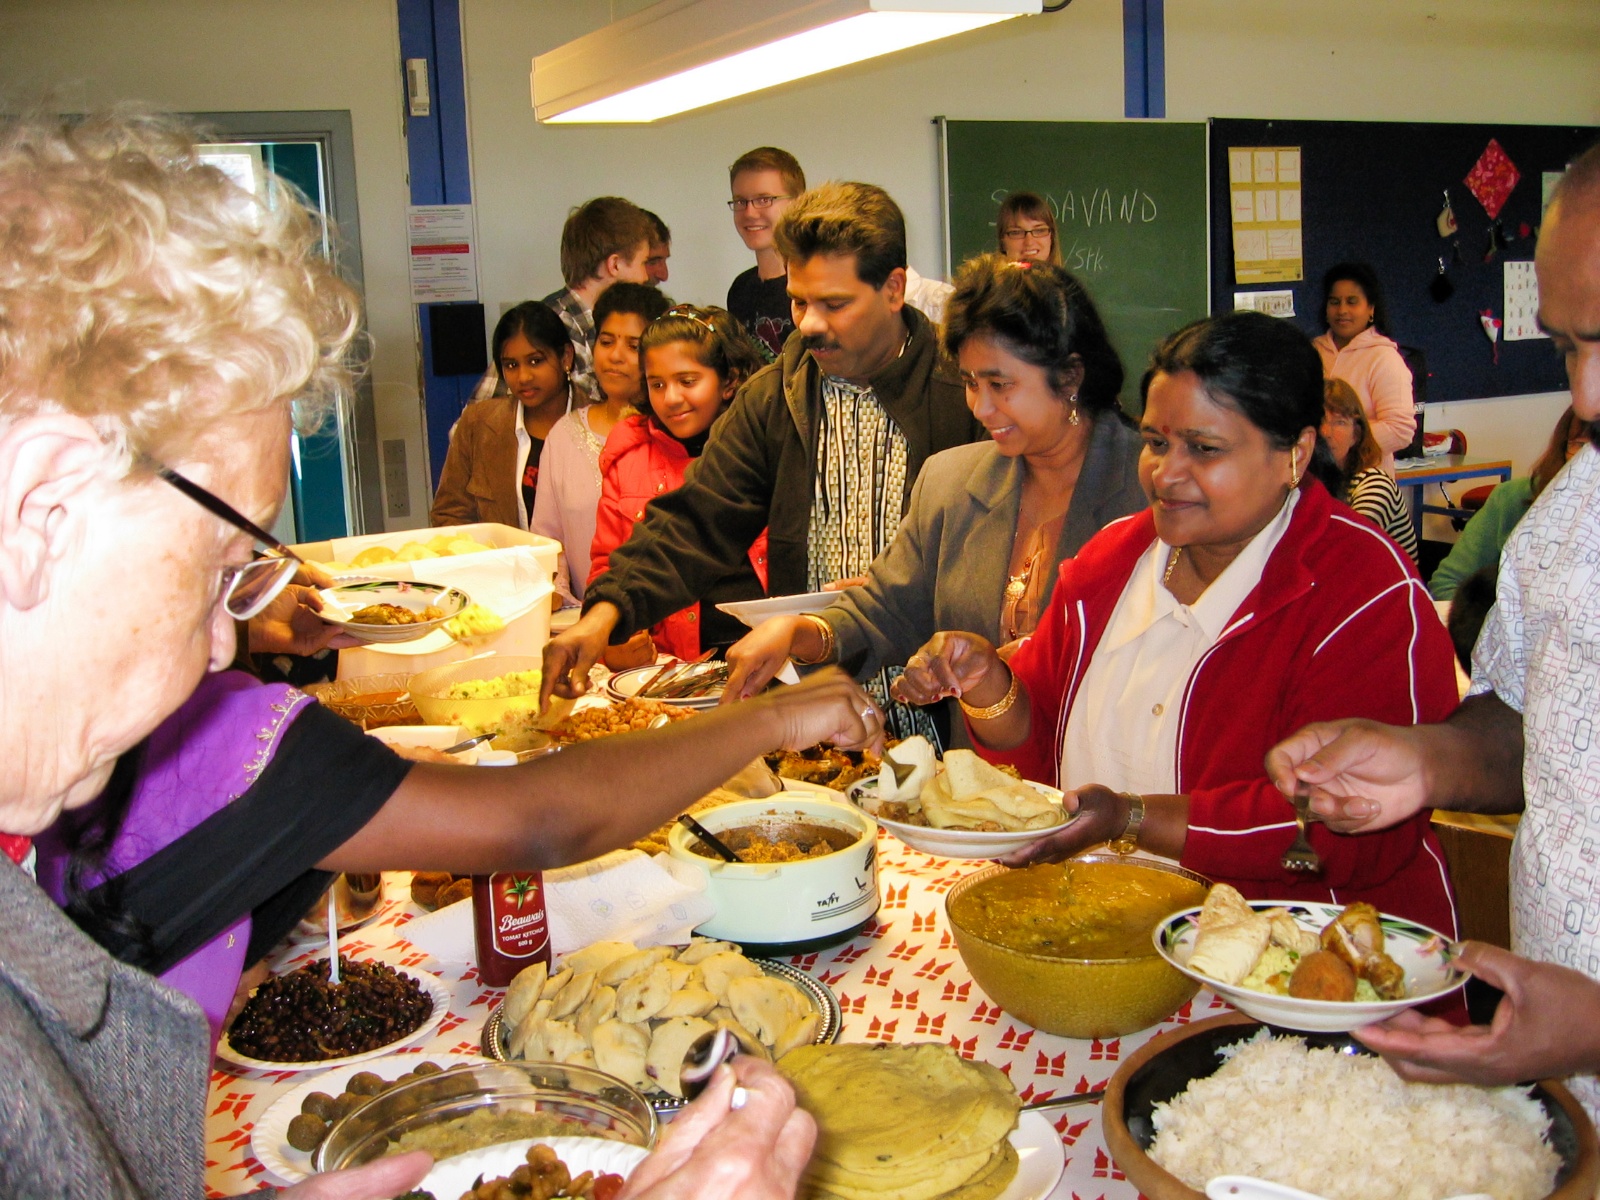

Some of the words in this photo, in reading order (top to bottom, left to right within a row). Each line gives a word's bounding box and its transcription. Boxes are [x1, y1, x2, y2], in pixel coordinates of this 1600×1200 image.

[988, 188, 1158, 228] SDAVAND
[498, 908, 545, 933] Beauvais
[502, 933, 522, 942] TOMAT
[522, 926, 545, 938] KETCHUP
